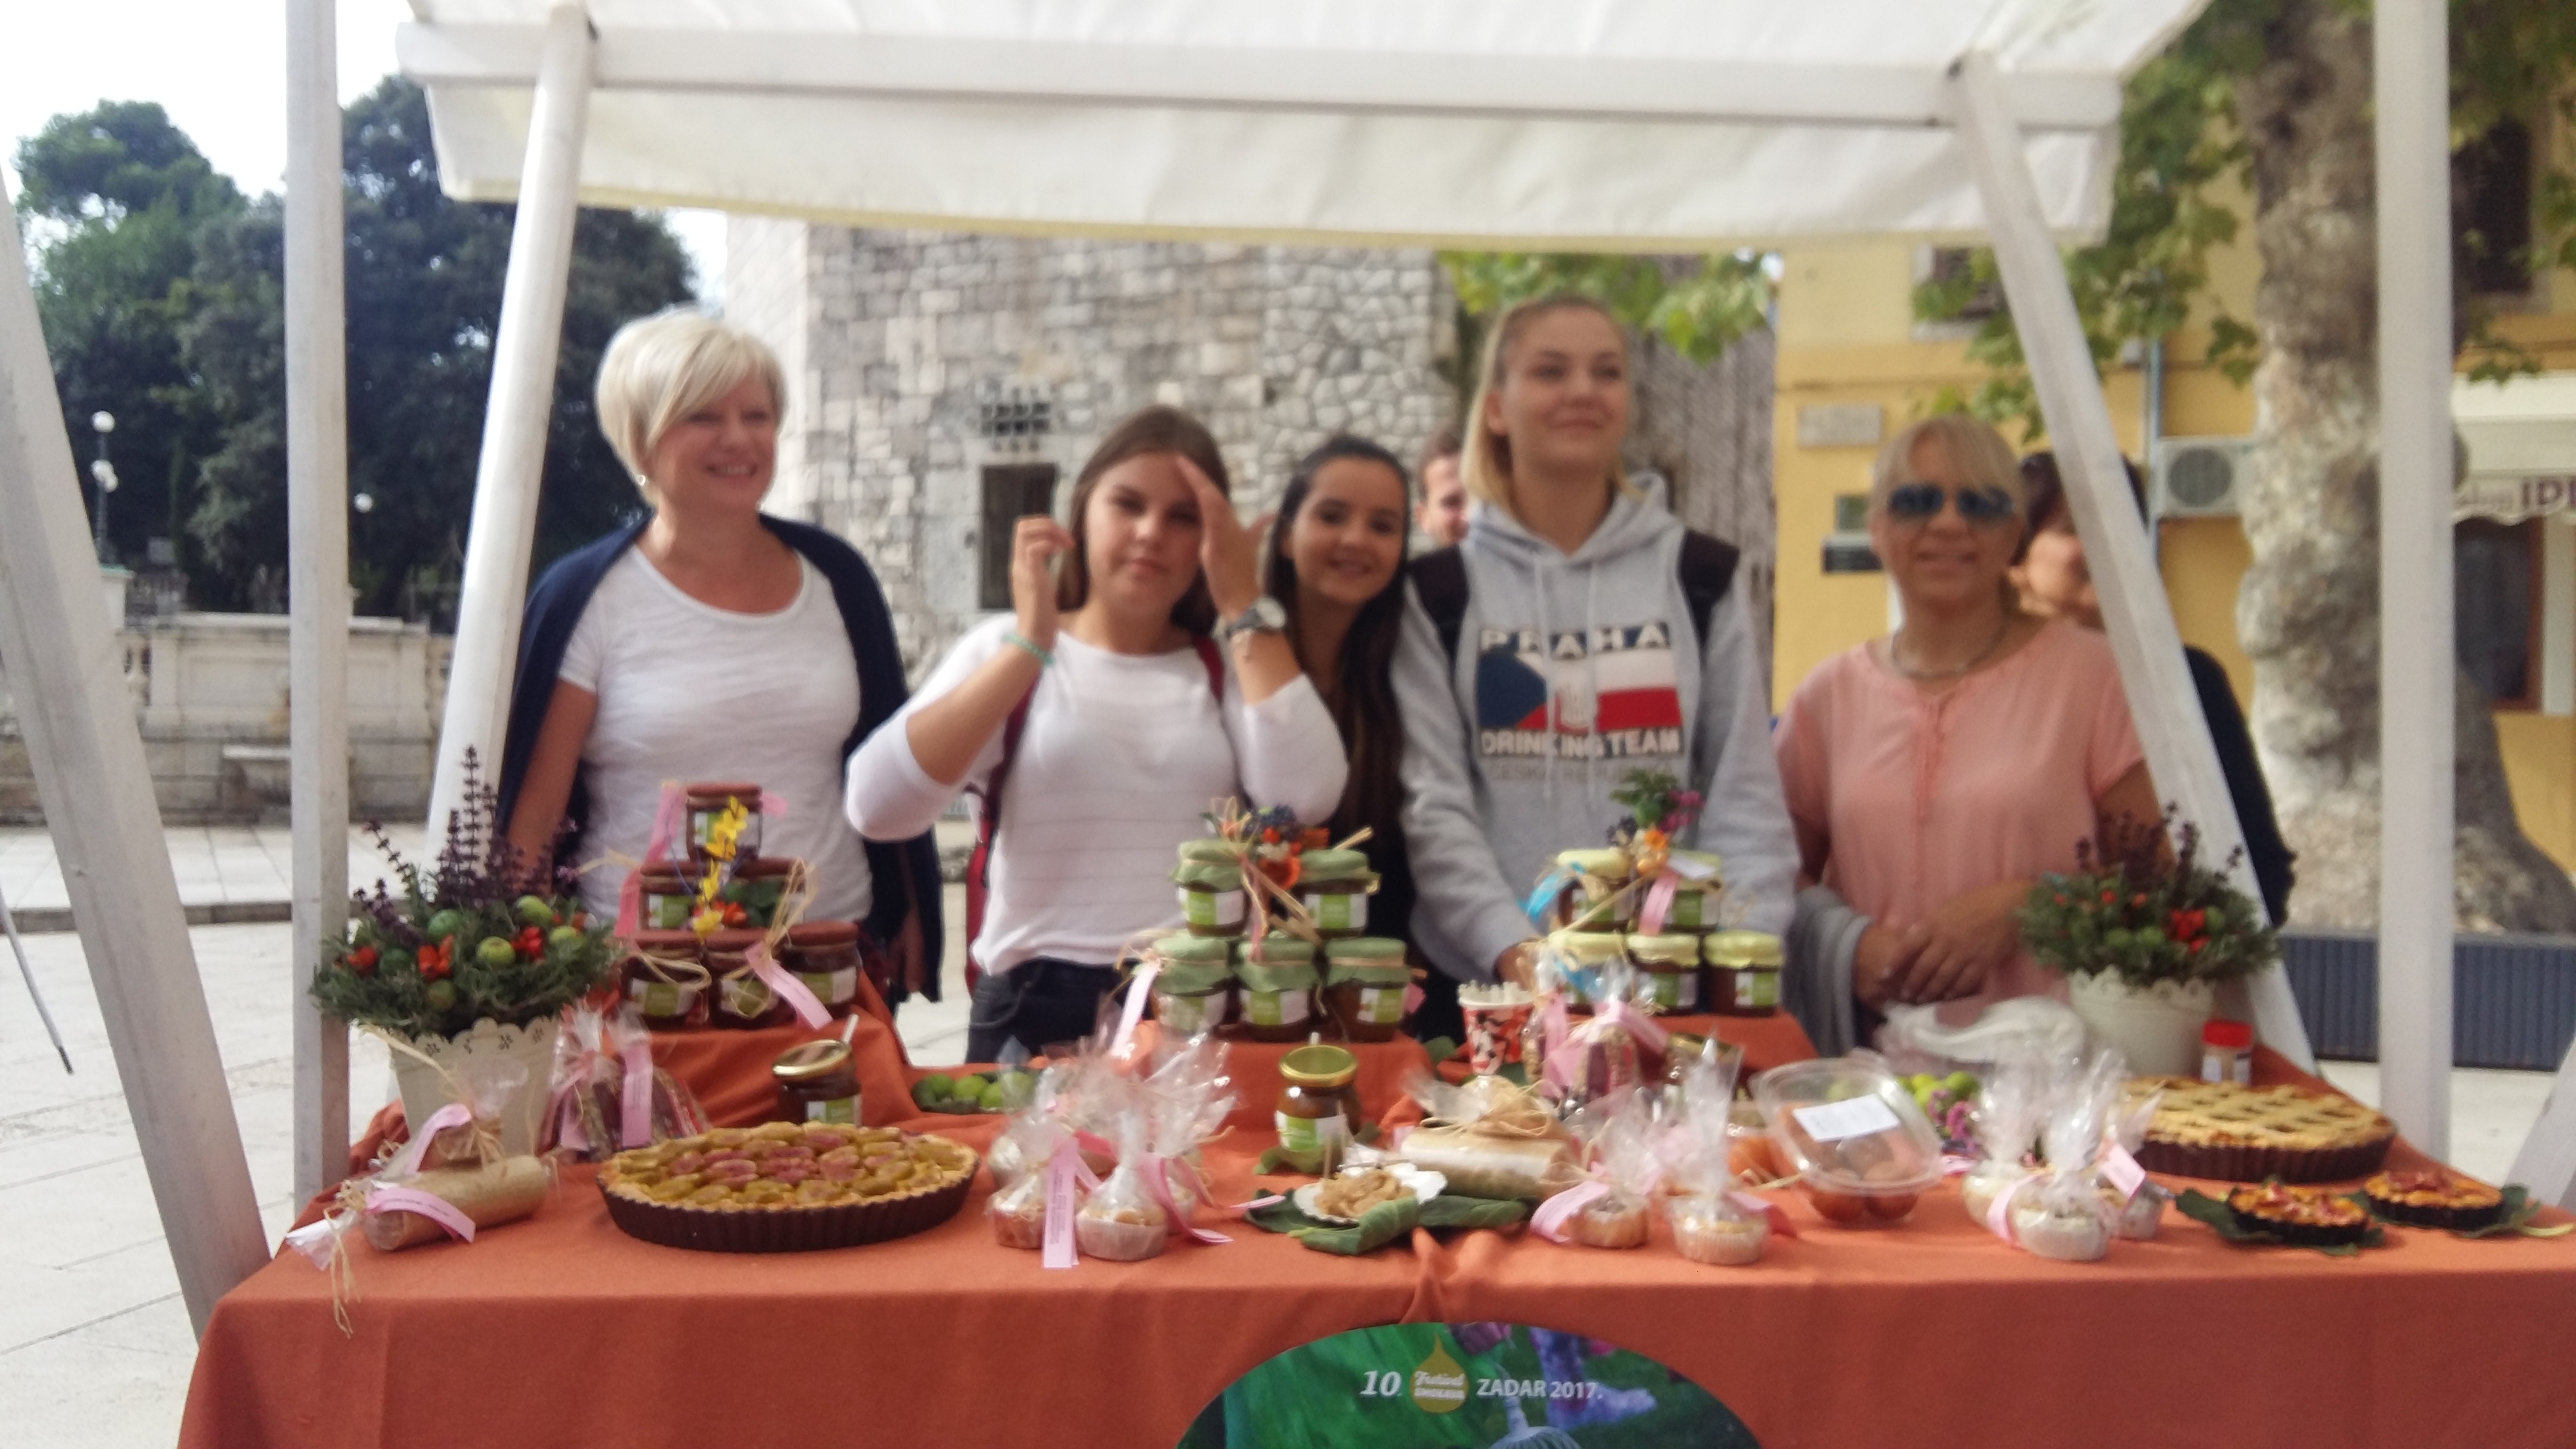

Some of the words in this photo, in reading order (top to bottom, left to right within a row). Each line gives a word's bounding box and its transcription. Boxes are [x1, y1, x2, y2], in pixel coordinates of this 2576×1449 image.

[1480, 623, 1672, 659] PRAHA
[1605, 727, 1681, 755] TEAM
[1476, 1378, 1547, 1397] ZADAR
[1549, 1380, 1604, 1399] 2017.
